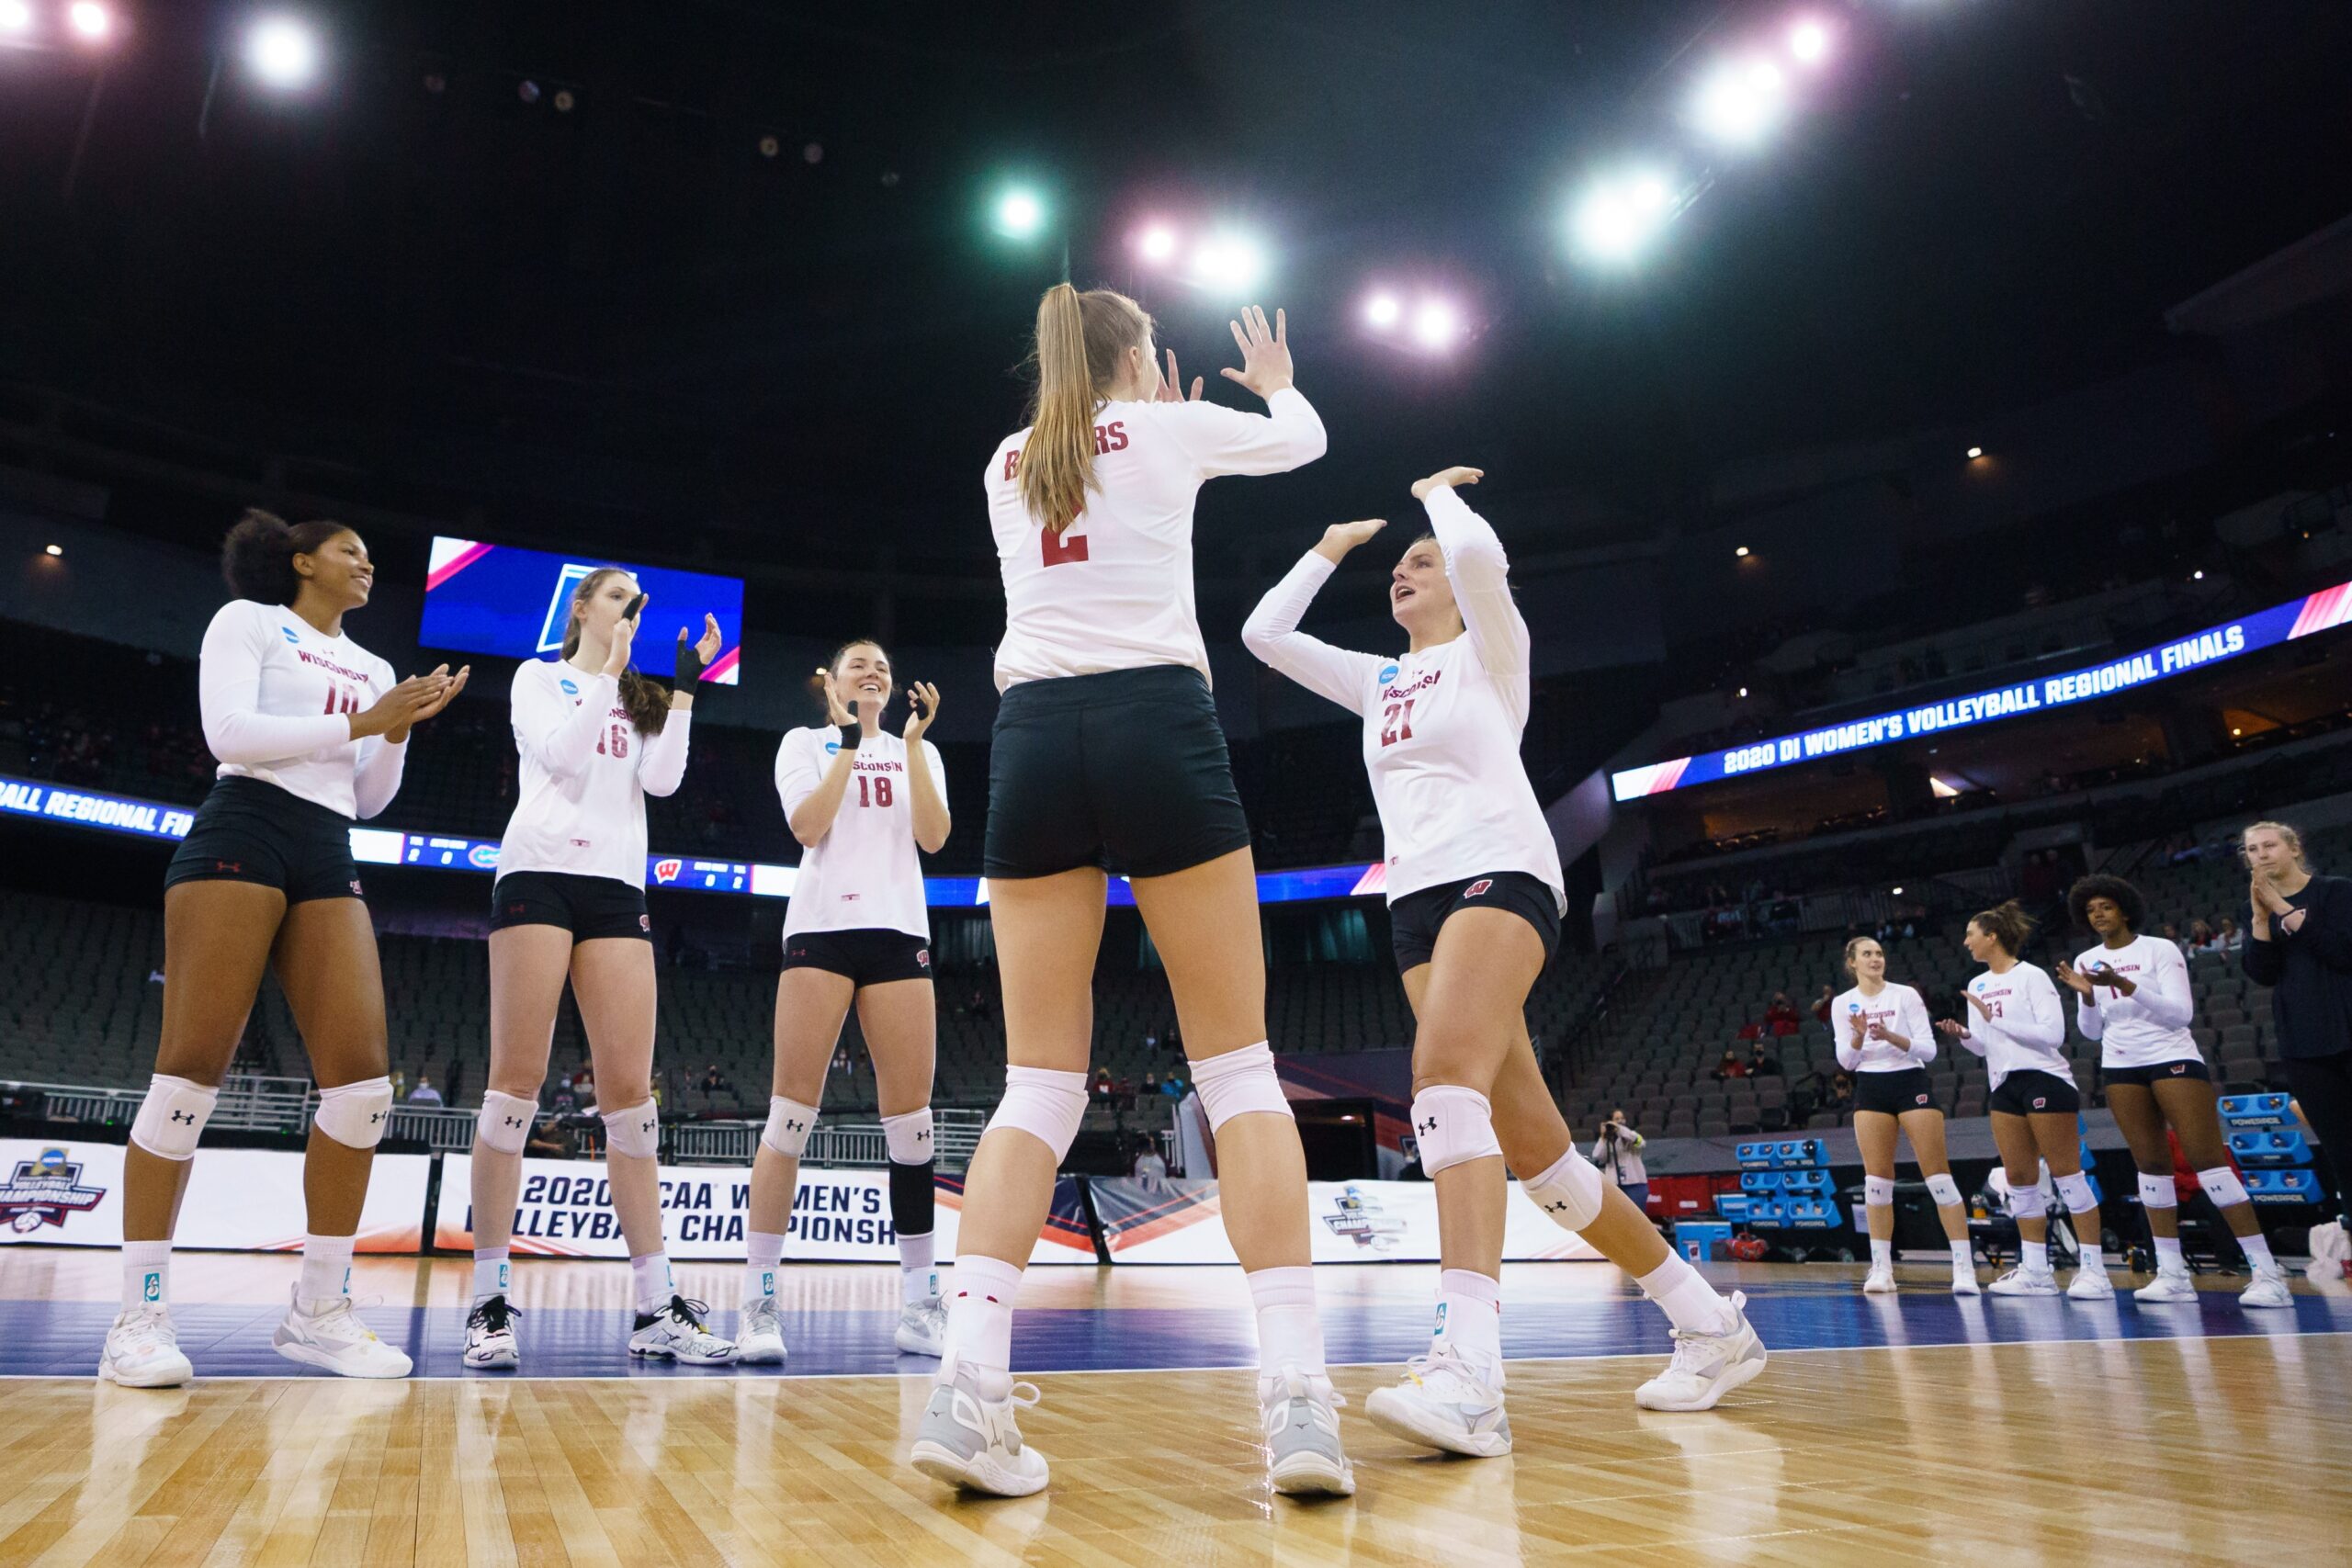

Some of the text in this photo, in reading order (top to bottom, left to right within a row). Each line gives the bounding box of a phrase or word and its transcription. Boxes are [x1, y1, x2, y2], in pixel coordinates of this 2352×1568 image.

[297, 649, 368, 682] WISCONSIN
[1724, 625, 2245, 773] 2020 DI WOMEN'S VOLLEYBALL REGIONAL FINALS
[1381, 698, 1415, 747] 21
[853, 760, 903, 773] SCONSIN
[857, 775, 893, 807] 18
[44, 791, 157, 831] REGIONAL
[660, 1181, 712, 1210] CAA
[731, 1184, 880, 1214] WMEN'S
[680, 1214, 896, 1246] CHAPIONSH
